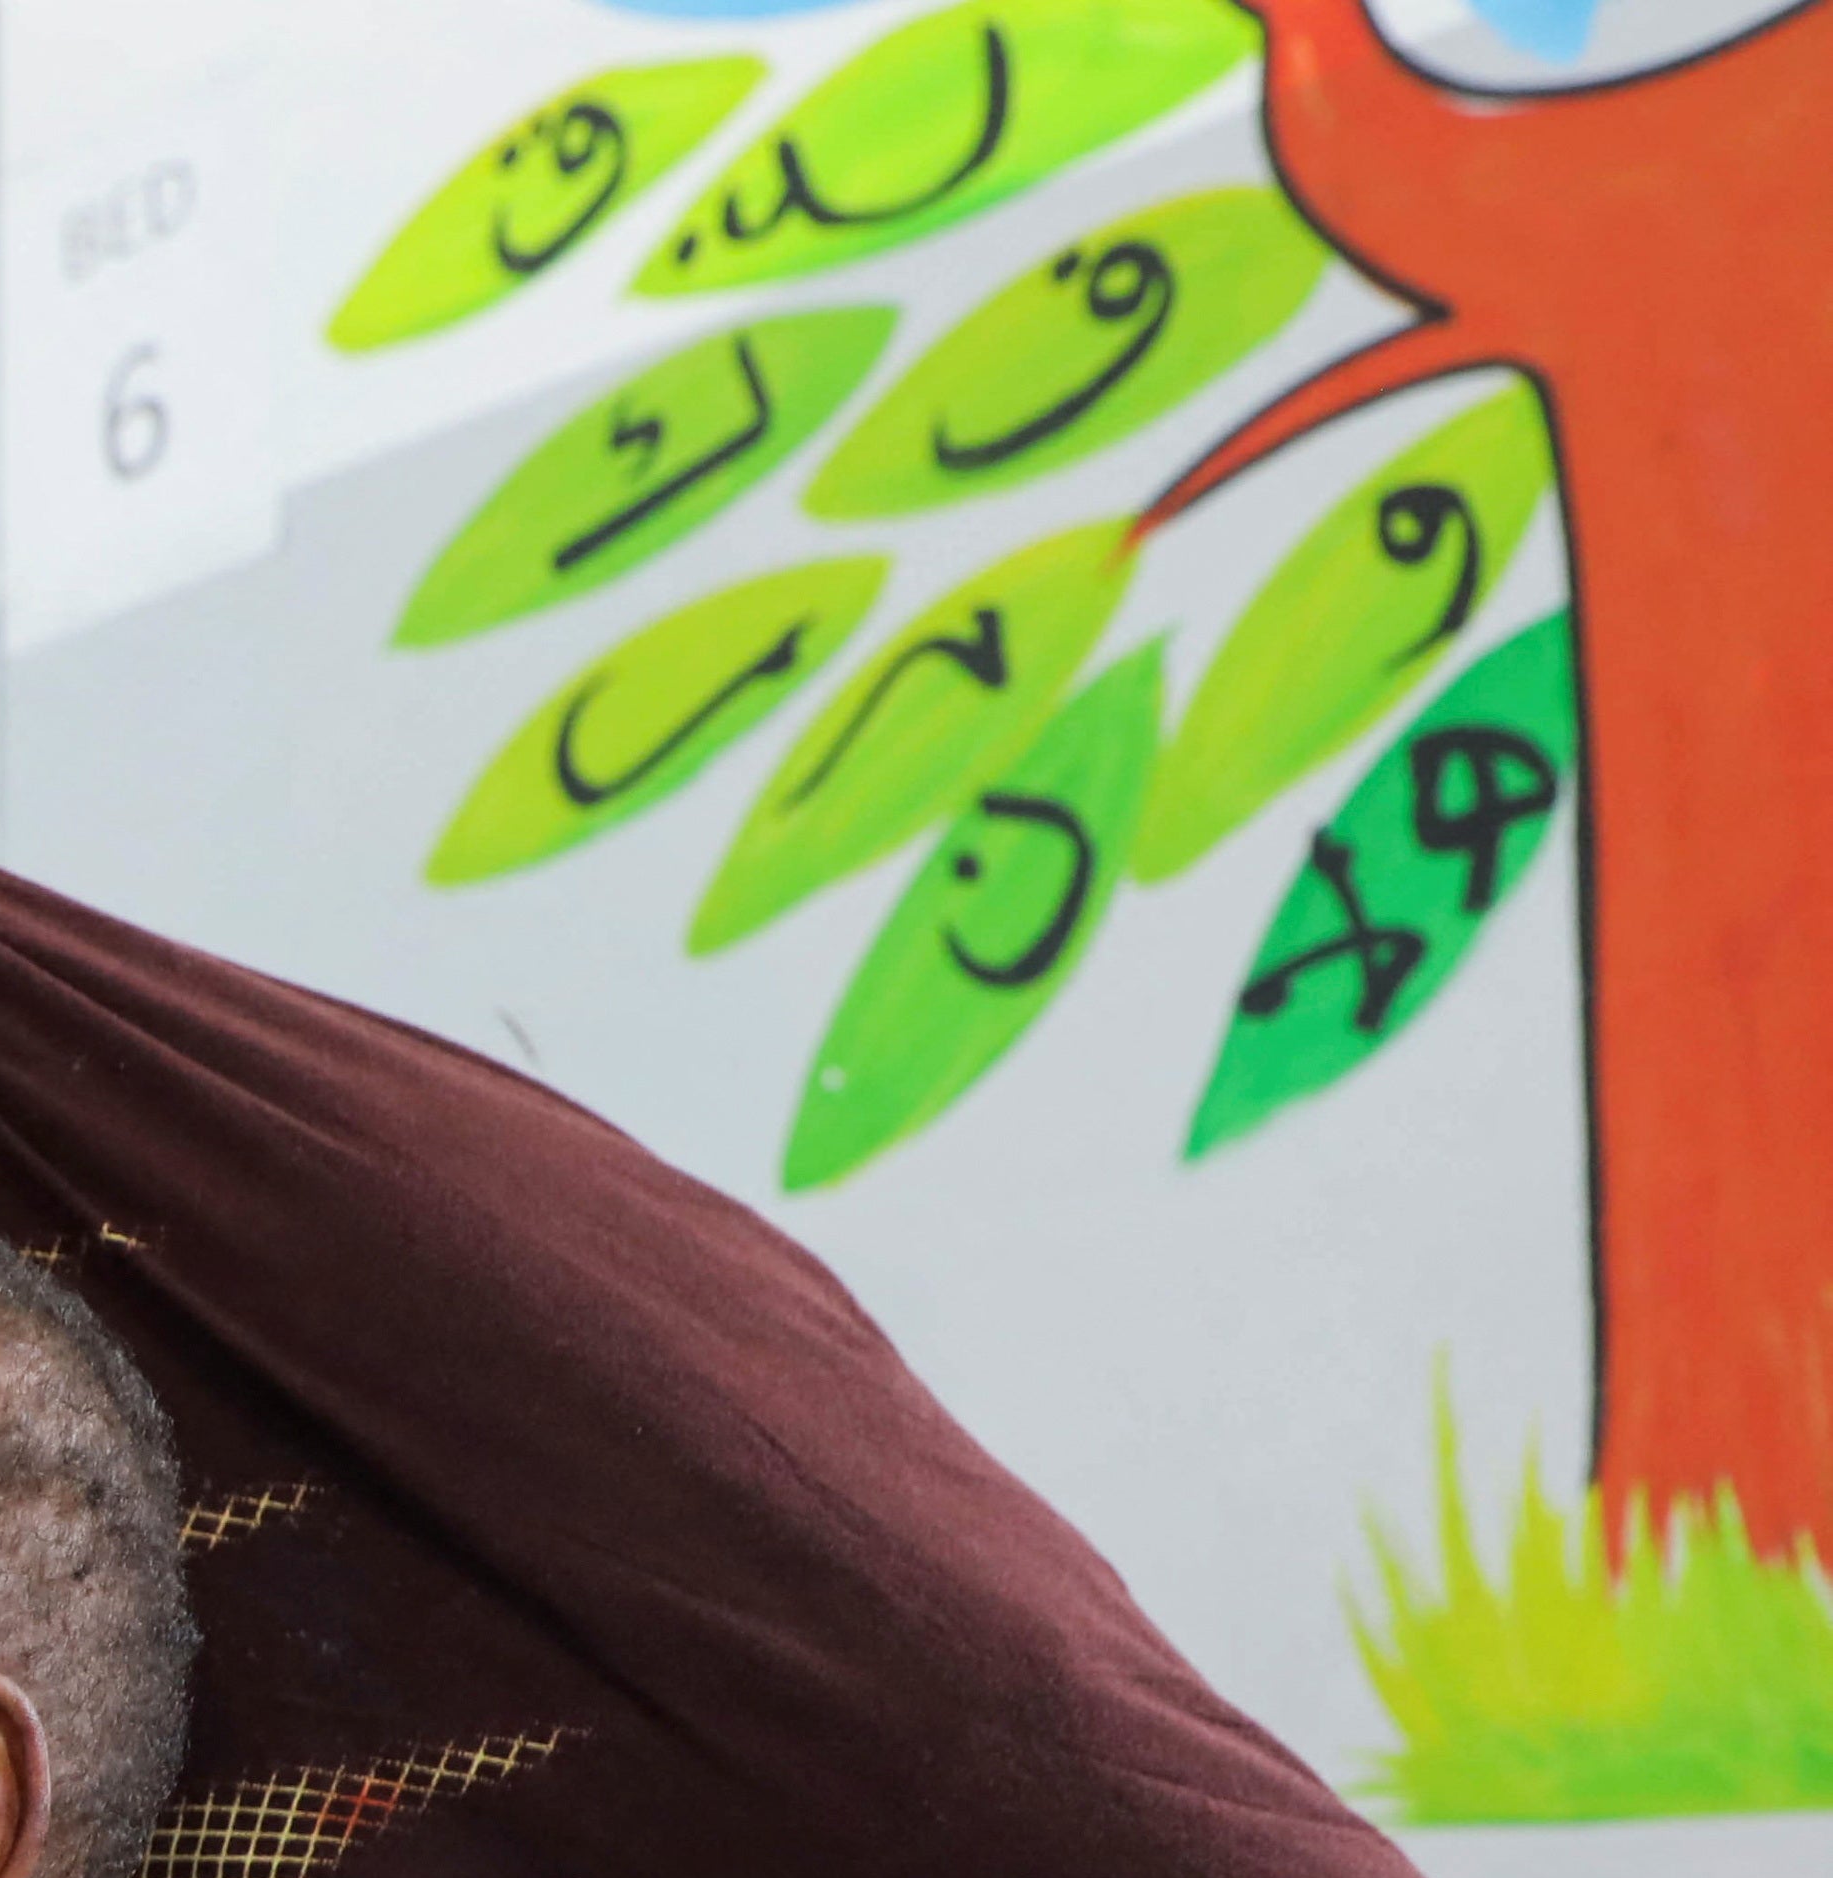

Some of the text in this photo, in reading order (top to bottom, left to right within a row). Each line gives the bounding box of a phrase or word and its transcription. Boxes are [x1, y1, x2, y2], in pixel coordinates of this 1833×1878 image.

[100, 338, 171, 484] 6
[1378, 484, 1481, 676] و
[944, 793, 1094, 988] ن
